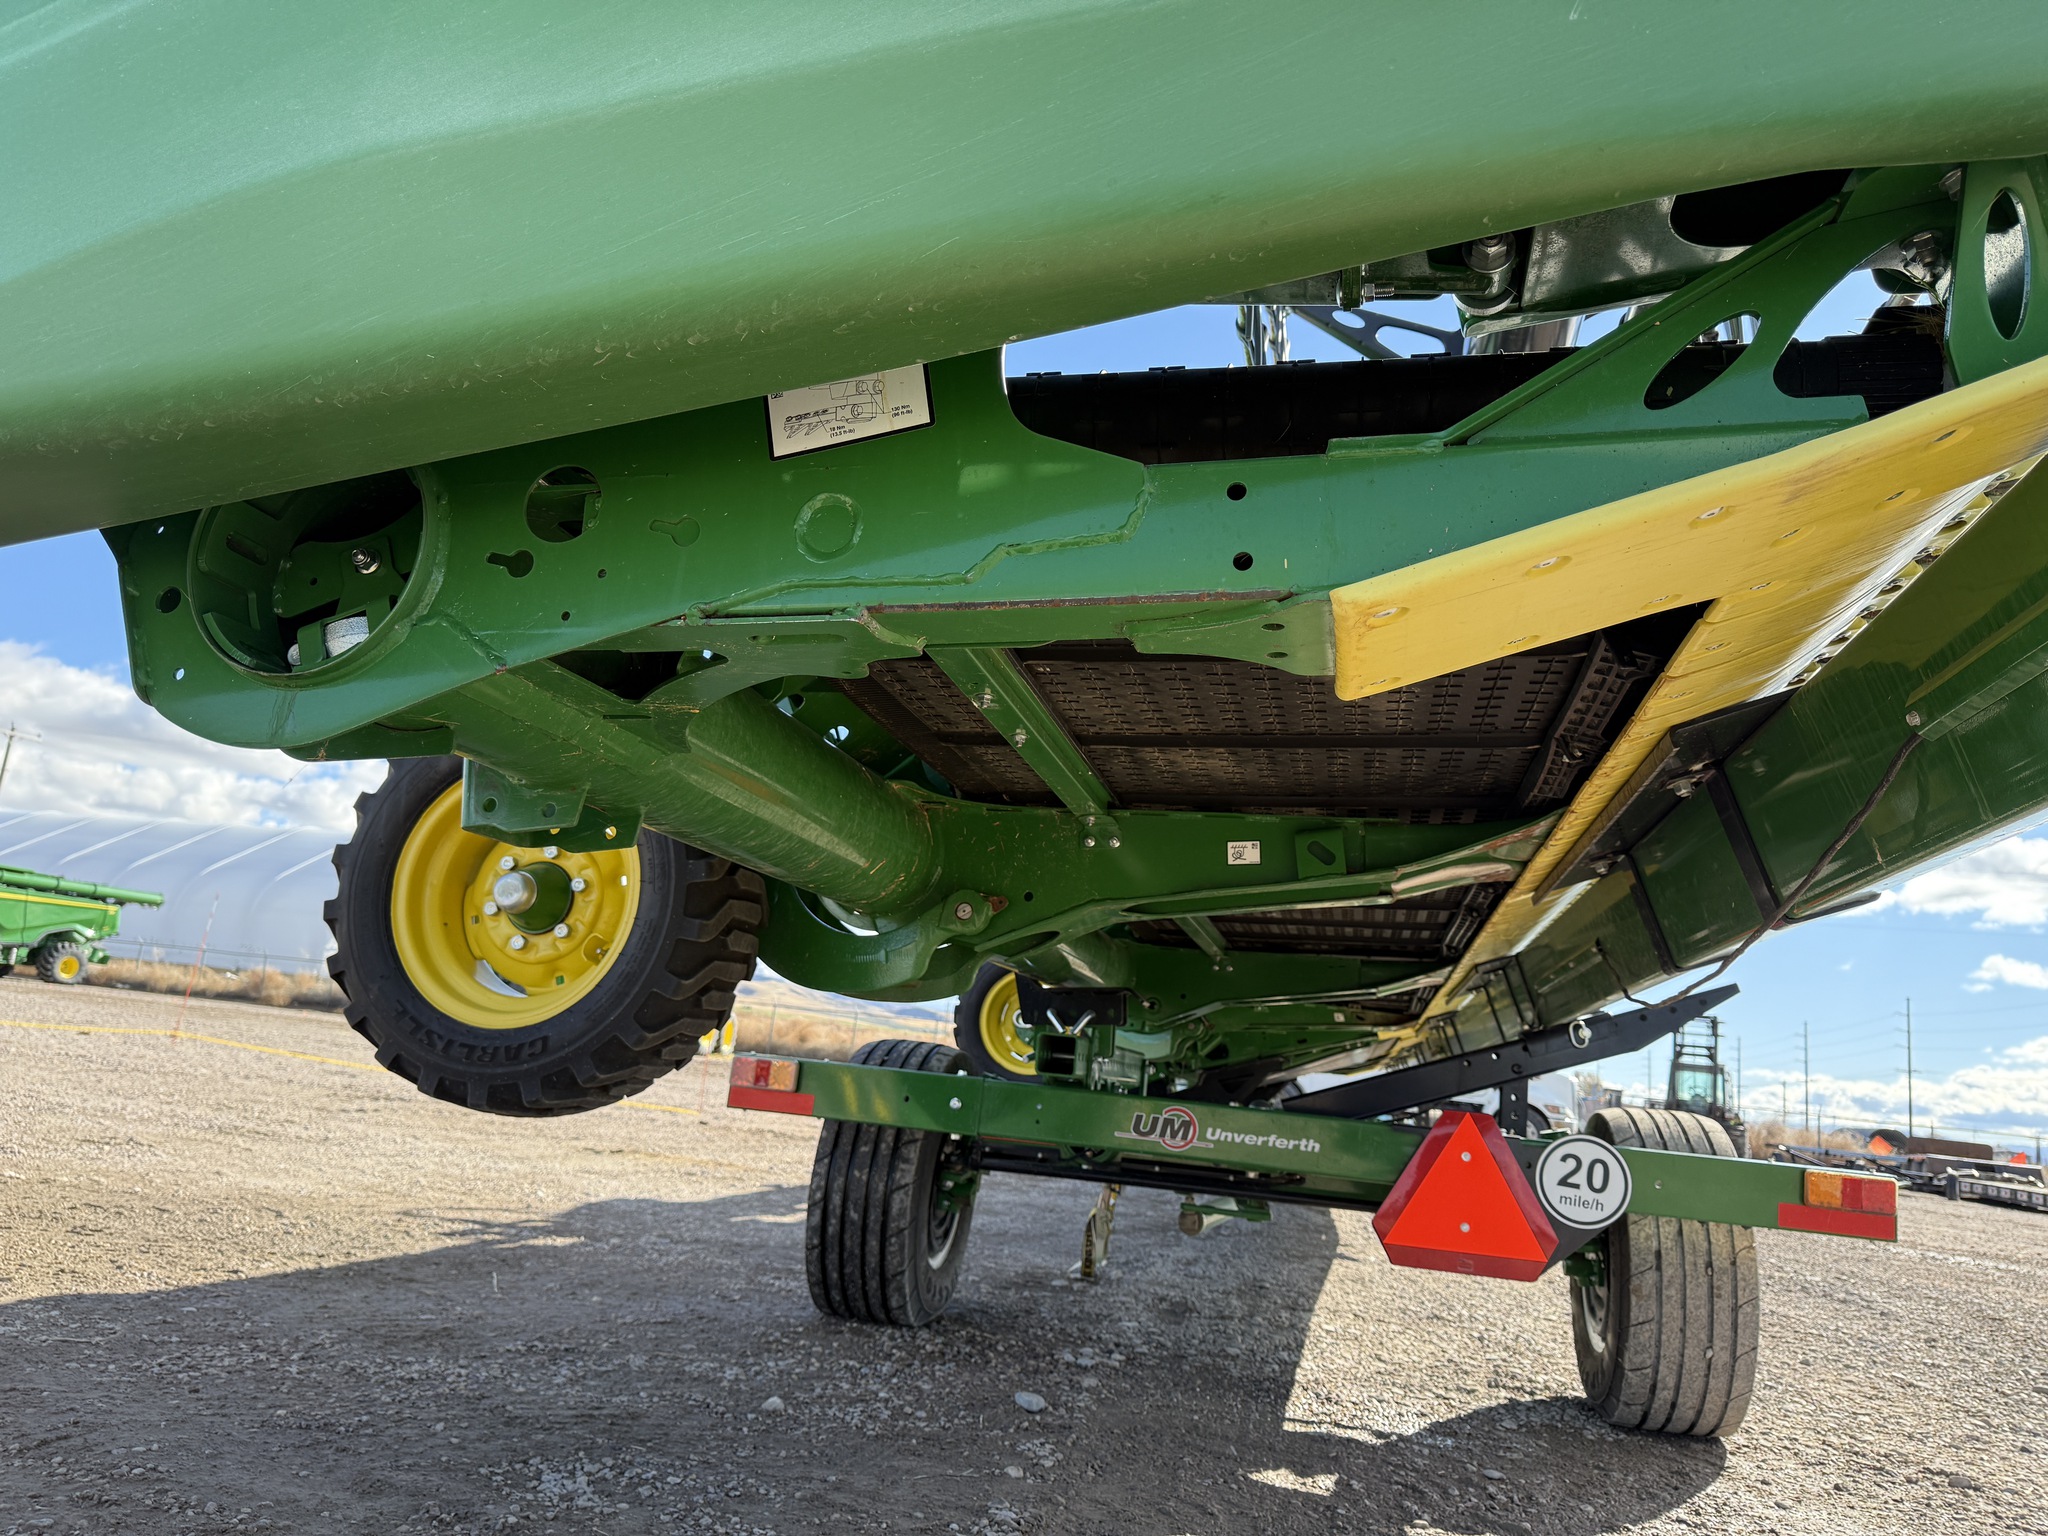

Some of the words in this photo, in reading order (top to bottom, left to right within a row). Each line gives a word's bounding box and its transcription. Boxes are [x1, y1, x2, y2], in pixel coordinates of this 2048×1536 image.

[394, 999, 550, 1063] CARLISLE
[1131, 1112, 1193, 1142] UM
[1205, 1126, 1321, 1153] Unverferth
[1556, 1153, 1610, 1194] 20
[1559, 1194, 1604, 1212] mile/h
